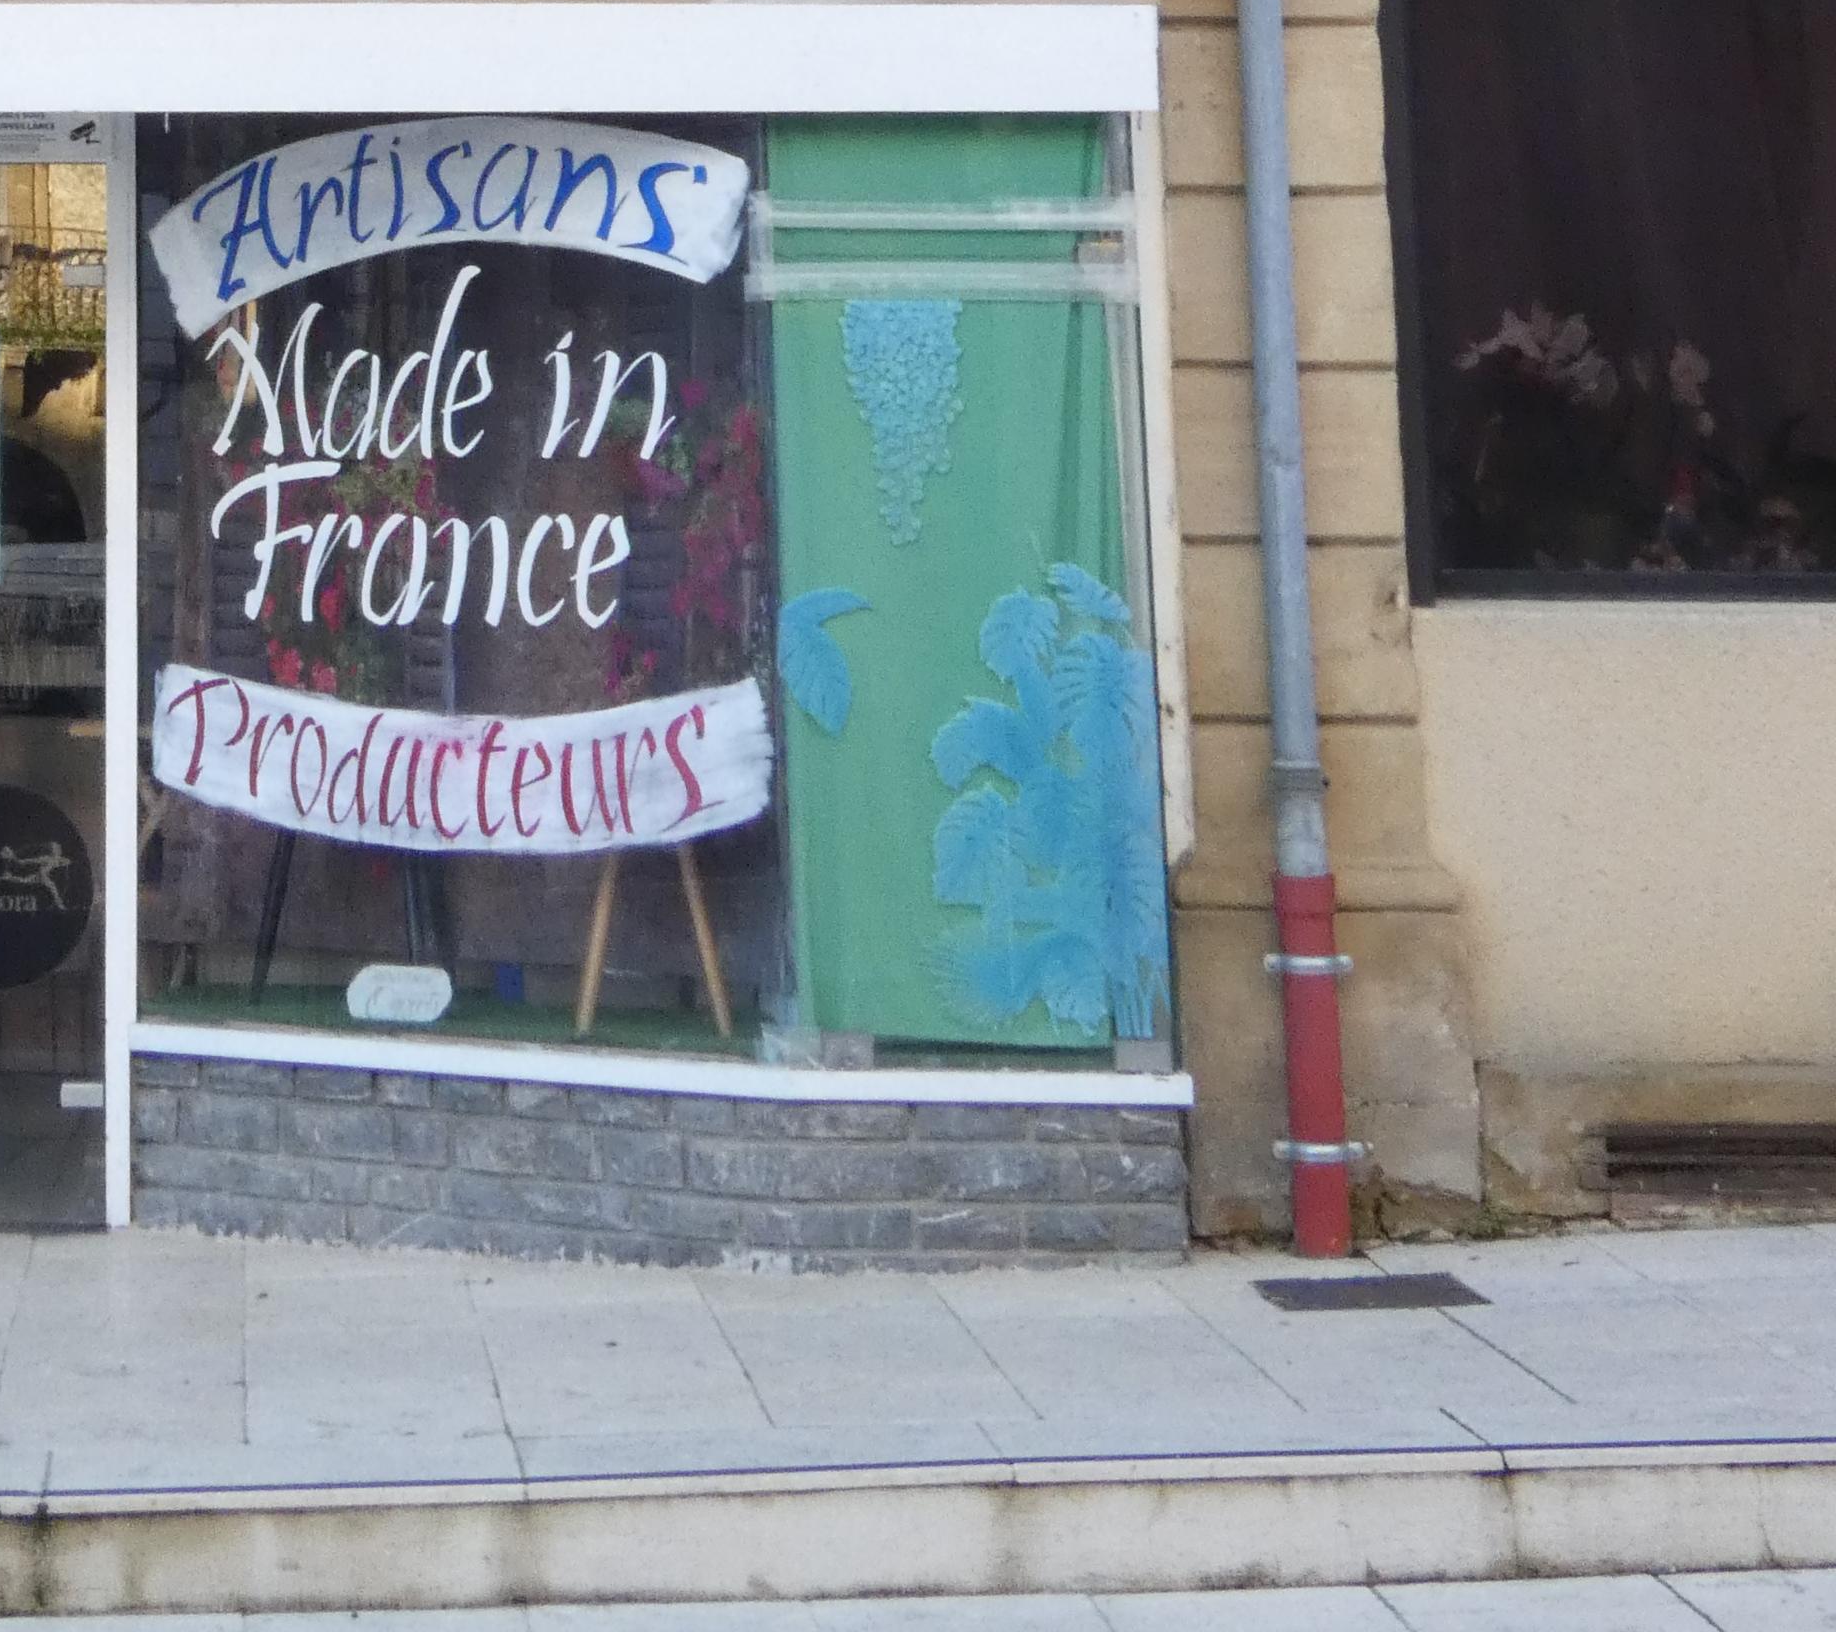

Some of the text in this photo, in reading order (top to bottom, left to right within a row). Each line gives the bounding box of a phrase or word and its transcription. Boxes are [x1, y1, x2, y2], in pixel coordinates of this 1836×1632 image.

[192, 133, 708, 302] Artisans
[205, 265, 676, 460] Made in
[210, 460, 631, 629] France
[167, 678, 725, 840] Producteurs
